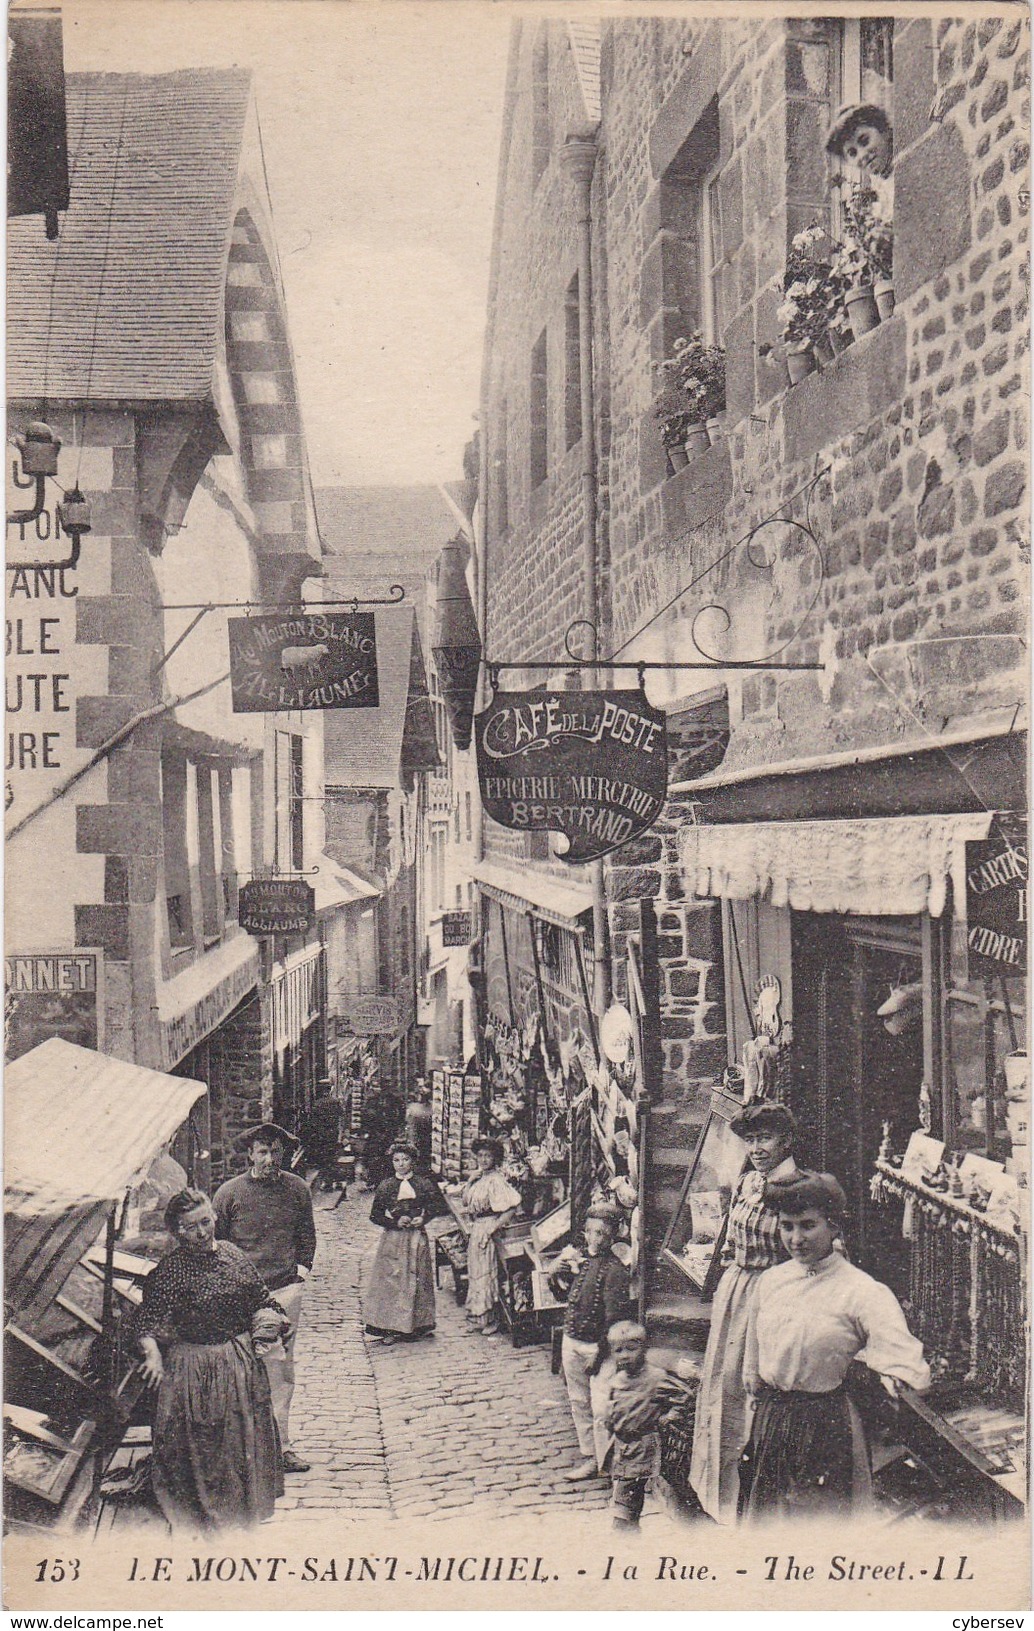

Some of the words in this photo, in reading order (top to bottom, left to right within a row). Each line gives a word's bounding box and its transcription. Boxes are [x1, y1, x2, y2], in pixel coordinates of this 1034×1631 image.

[483, 697, 563, 758] CAFÉ
[600, 700, 662, 753] POSTE
[571, 775, 658, 822] MERCERIE
[511, 801, 634, 844] BERTRAND
[968, 926, 1024, 965] CIDRE
